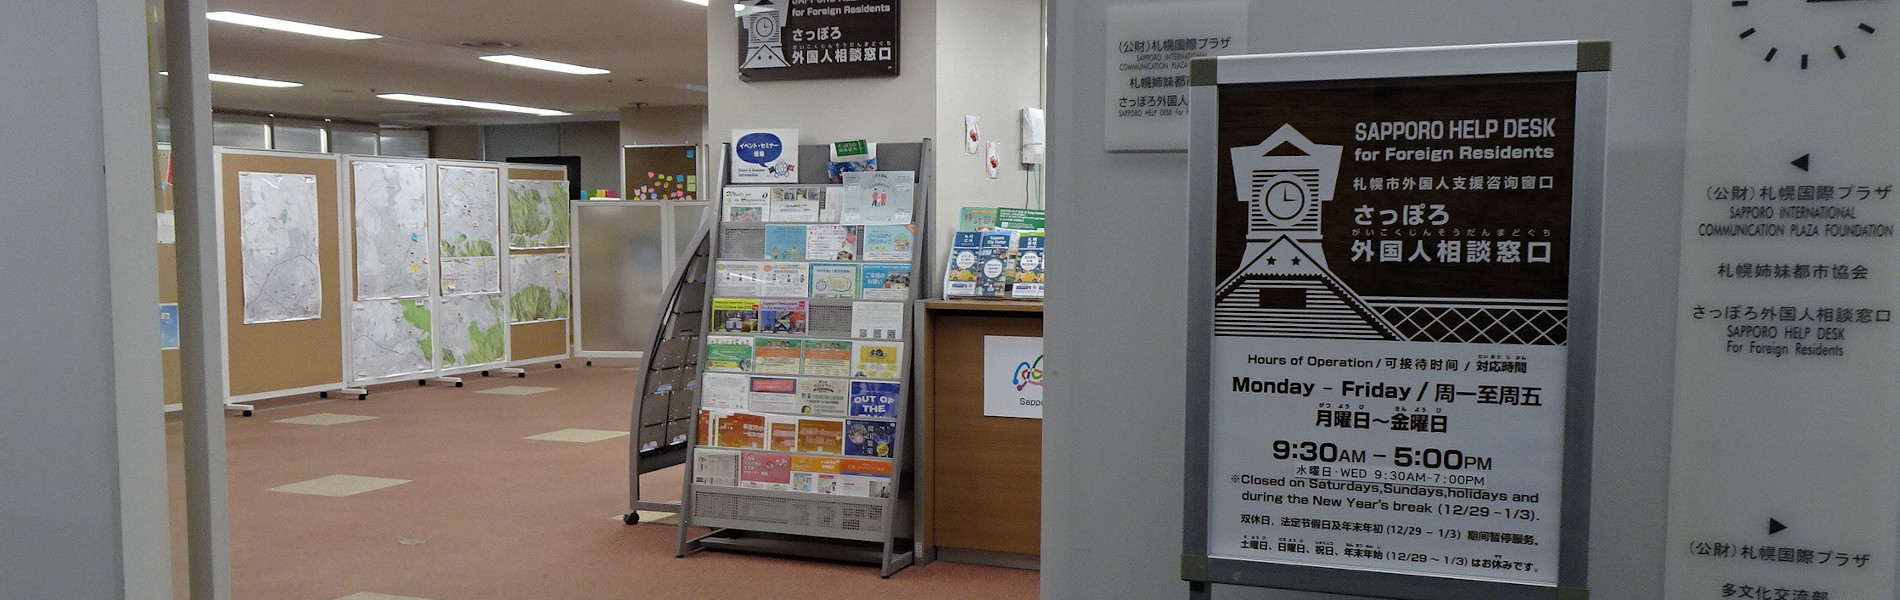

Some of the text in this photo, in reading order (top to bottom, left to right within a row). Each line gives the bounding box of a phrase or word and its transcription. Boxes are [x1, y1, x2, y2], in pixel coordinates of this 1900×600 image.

[792, 4, 890, 17] for Foreign Residents
[792, 26, 842, 41] さっぽろ
[792, 48, 892, 64] 外国人相談窓口
[1136, 54, 1162, 62] SAPPORO
[1119, 62, 1168, 70] COMMUNICATION
[1354, 118, 1556, 142] SAPPORO HELP DESK
[1354, 144, 1554, 162] for Foreign Residents
[1352, 176, 1554, 192] 札幌市外国人支援咨询窗口
[1706, 184, 1893, 201] (公財)札幌国際プラザ
[1354, 204, 1450, 226] さっぽろ
[1730, 206, 1856, 219] SAPPORO INTERNATIONAL
[1352, 228, 1552, 237] がいこくじんそうだんまどぐち
[1698, 224, 1894, 237] COMMUNICATION PLAZA FOUNDATION
[1350, 240, 1552, 264] 外国人相談窓口
[1717, 262, 1868, 280] 札幌姉妹都市協会
[1692, 304, 1892, 323] さっぽろ外国人相談窓口
[1726, 326, 1846, 340] SAPPORO HELP DESK
[1726, 341, 1844, 358] For Foreign Residents
[1248, 354, 1286, 365] Hours
[1290, 356, 1304, 366] of
[1308, 356, 1372, 368] Operation
[1385, 357, 1458, 372] 可接待时间
[1476, 360, 1527, 373] 対応時間
[854, 395, 896, 404] OUT OF
[1232, 376, 1314, 397] Monday
[1342, 381, 1410, 401] Friday
[1435, 384, 1542, 407] 周一至周五
[862, 404, 886, 412] THE
[1272, 440, 1366, 463] 9:30AM
[1394, 446, 1492, 470] 5:00PM
[1374, 469, 1485, 486] 9:30AM-7:00PM
[1290, 479, 1304, 488] on
[1512, 493, 1539, 503] and
[1242, 490, 1282, 504] during
[1288, 494, 1308, 504] the
[1312, 496, 1342, 506] New
[1346, 498, 1388, 510] Year's
[1393, 500, 1432, 513] break
[1438, 504, 1489, 517] (12/29
[1387, 524, 1422, 536] (12/29
[1438, 528, 1461, 540] 1/3)
[1386, 551, 1427, 563] (12/29
[1445, 556, 1468, 566] 1/3)
[1472, 558, 1538, 572] はお休みです。
